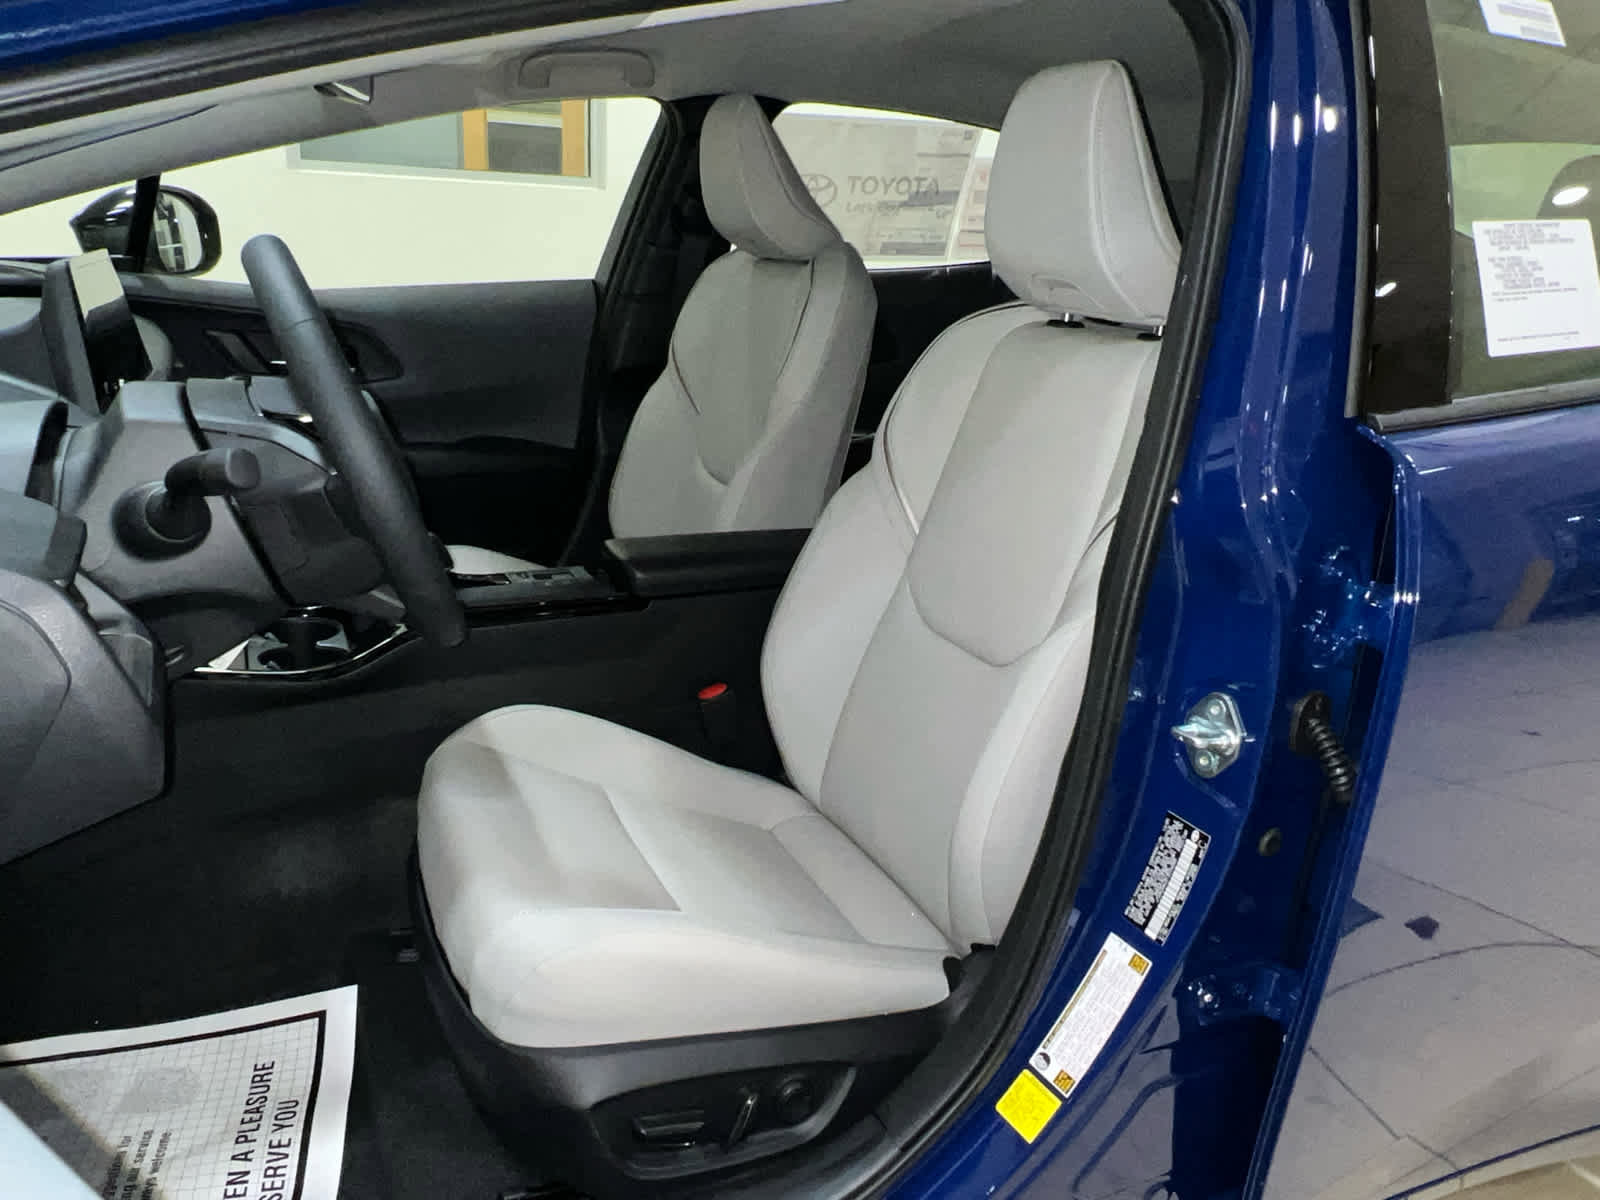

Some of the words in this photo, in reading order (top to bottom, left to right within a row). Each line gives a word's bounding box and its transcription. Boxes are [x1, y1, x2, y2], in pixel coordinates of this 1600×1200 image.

[848, 175, 939, 196] TOYOTA
[234, 1060, 275, 1145] PLEASURE
[271, 1099, 299, 1134] YOU
[230, 1149, 255, 1162] A
[259, 1137, 291, 1200] SERVE
[223, 1170, 250, 1200] EN
